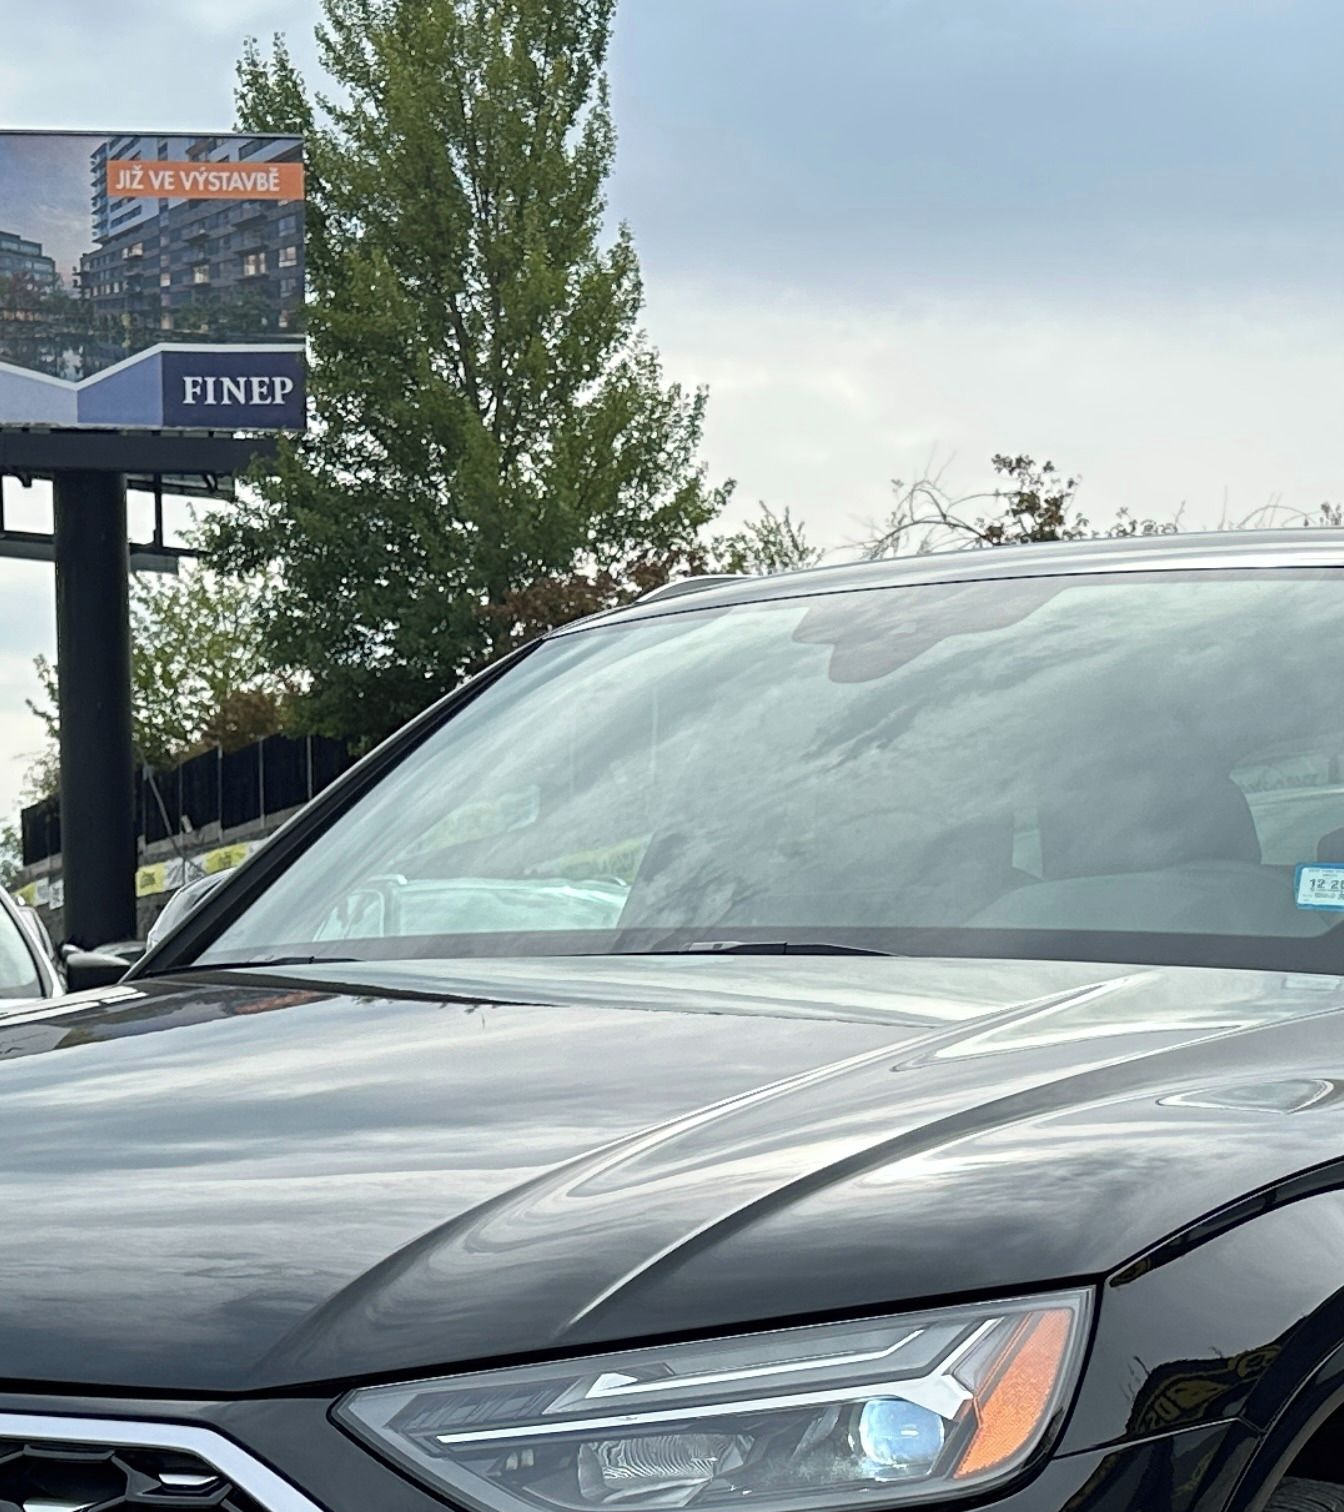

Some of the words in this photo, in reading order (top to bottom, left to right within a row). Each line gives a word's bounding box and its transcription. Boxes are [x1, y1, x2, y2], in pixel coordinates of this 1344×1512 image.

[115, 164, 145, 190] JIŽ
[148, 170, 176, 191] VE
[179, 167, 281, 192] VÝSTAVBĚ
[182, 376, 294, 405] FINEP
